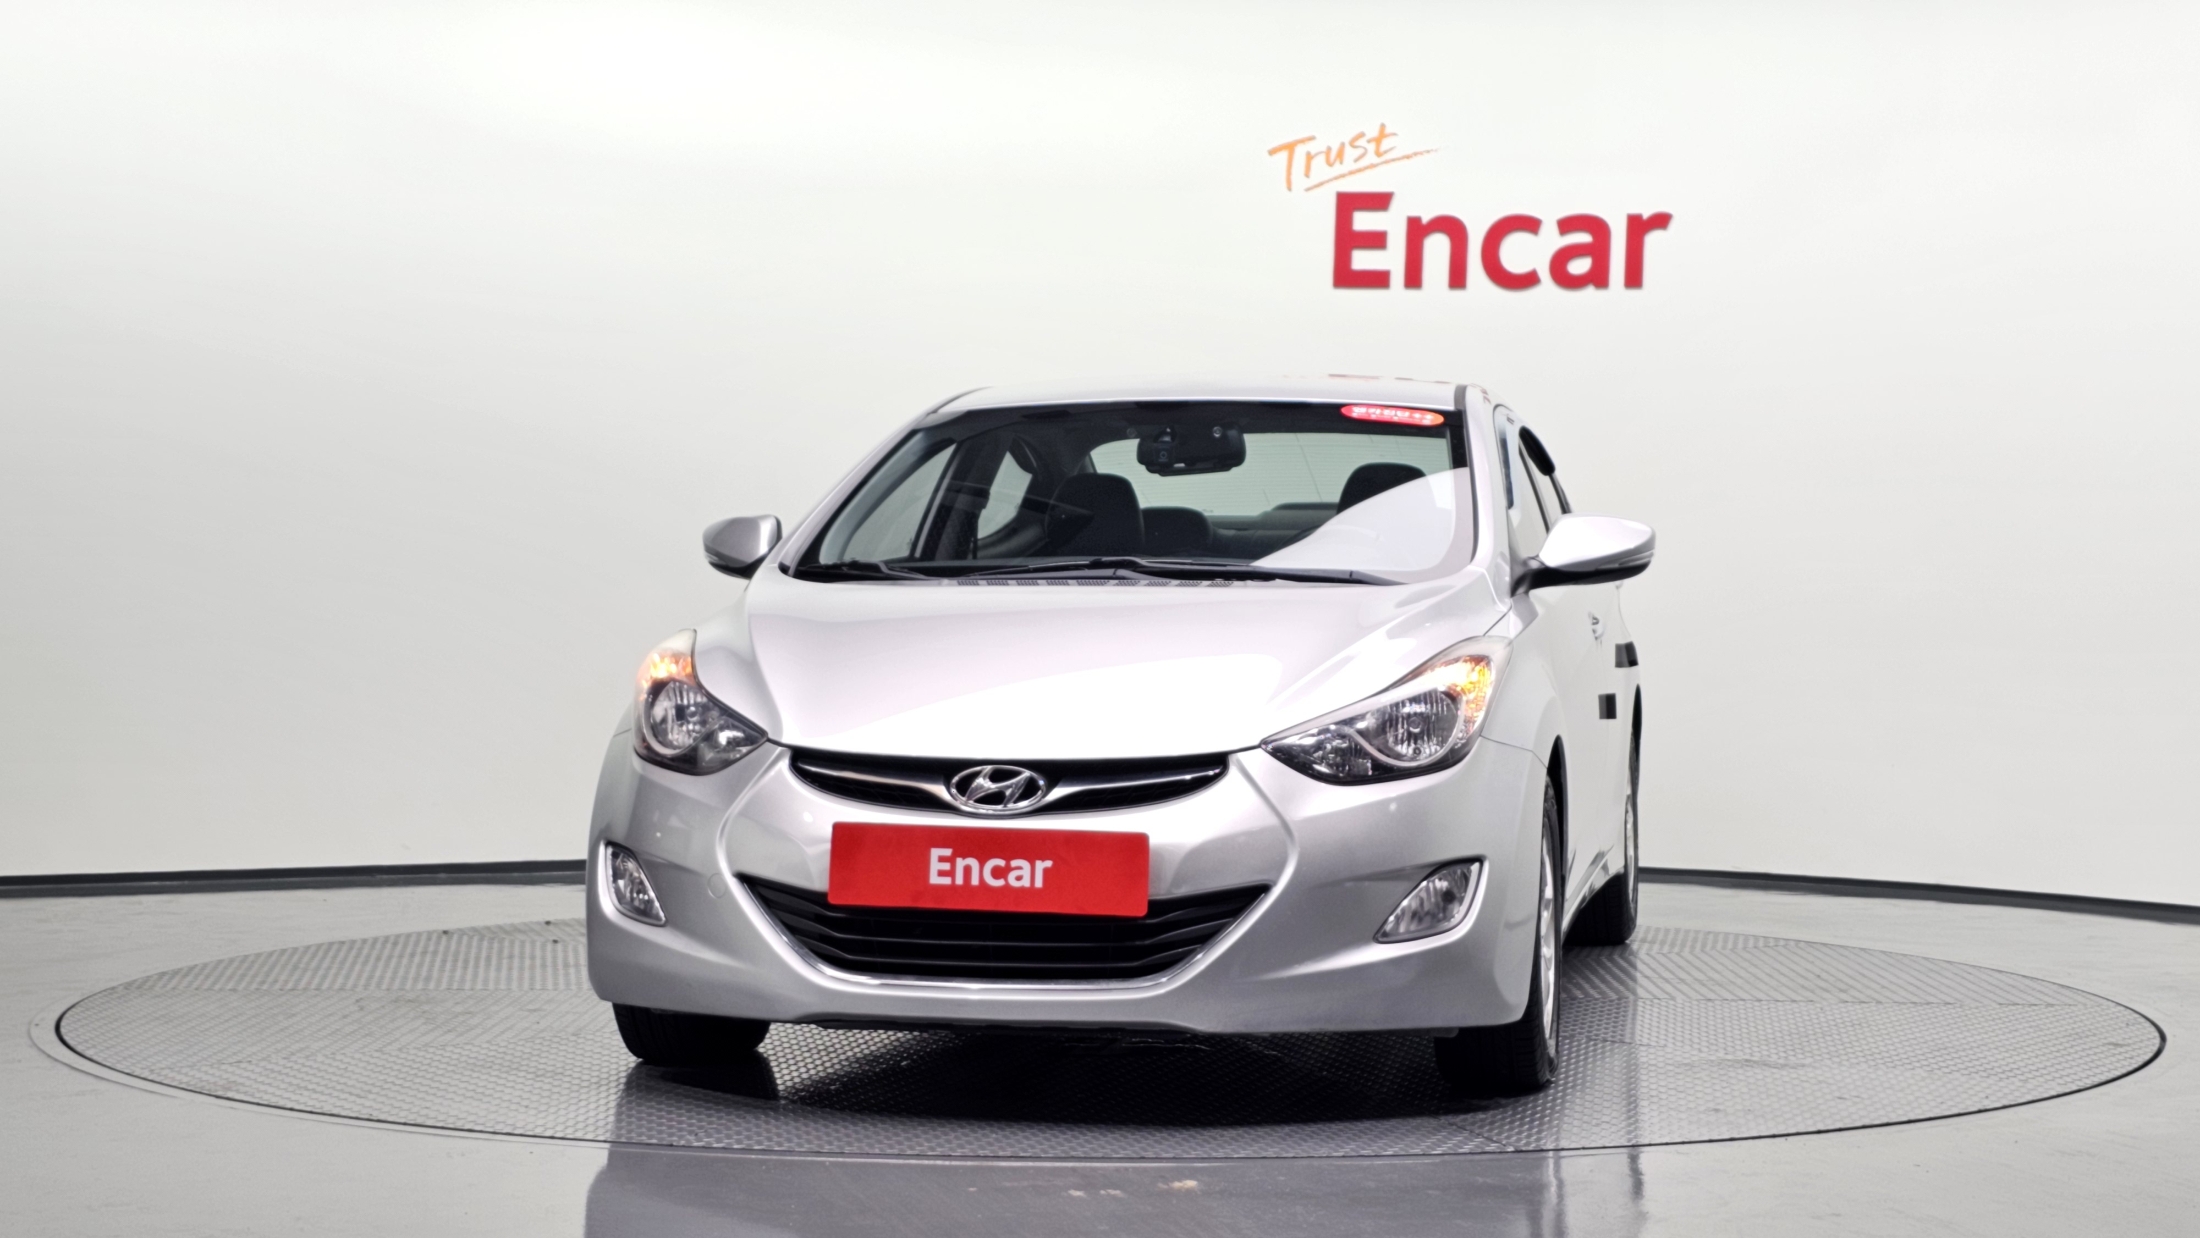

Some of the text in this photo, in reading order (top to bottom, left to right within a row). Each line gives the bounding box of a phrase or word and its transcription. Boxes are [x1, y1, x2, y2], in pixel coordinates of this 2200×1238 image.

[1267, 122, 1400, 191] Trust
[1333, 191, 1673, 290] Encar
[929, 847, 1053, 888] Encar
